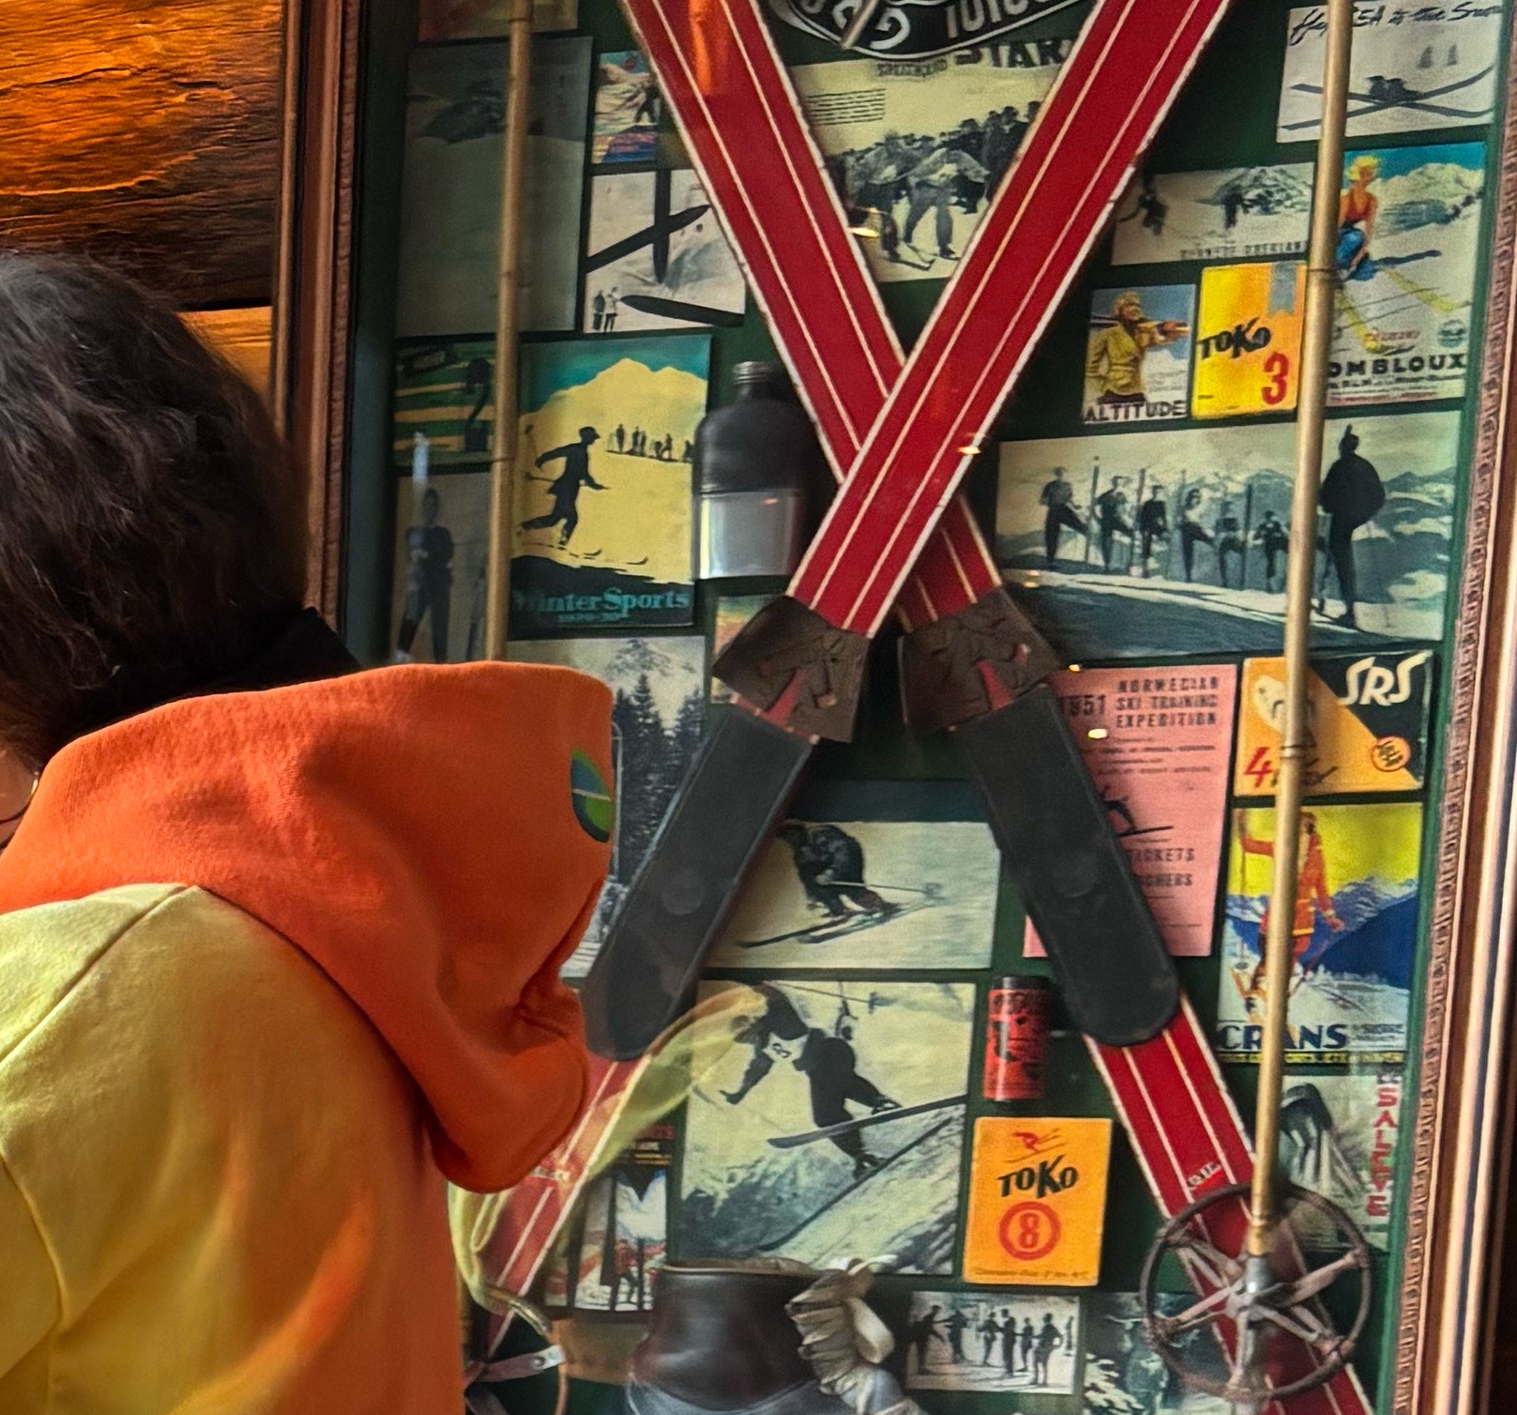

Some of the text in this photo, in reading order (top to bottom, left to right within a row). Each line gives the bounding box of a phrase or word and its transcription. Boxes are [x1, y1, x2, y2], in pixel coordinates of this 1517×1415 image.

[1197, 317, 1272, 359] TOKO
[1261, 351, 1289, 405] 3
[1326, 353, 1468, 378] OMBLOUX
[1084, 400, 1188, 421] ALTITUDE
[1117, 676, 1220, 693] NORWEGIAN
[1337, 650, 1433, 706] SRS
[1115, 694, 1219, 712] SKI TRAINING
[1115, 712, 1217, 729] EXPEDITION
[1243, 745, 1274, 789] 4
[996, 1153, 1079, 1199] TOKO
[1018, 1212, 1040, 1249] 8
